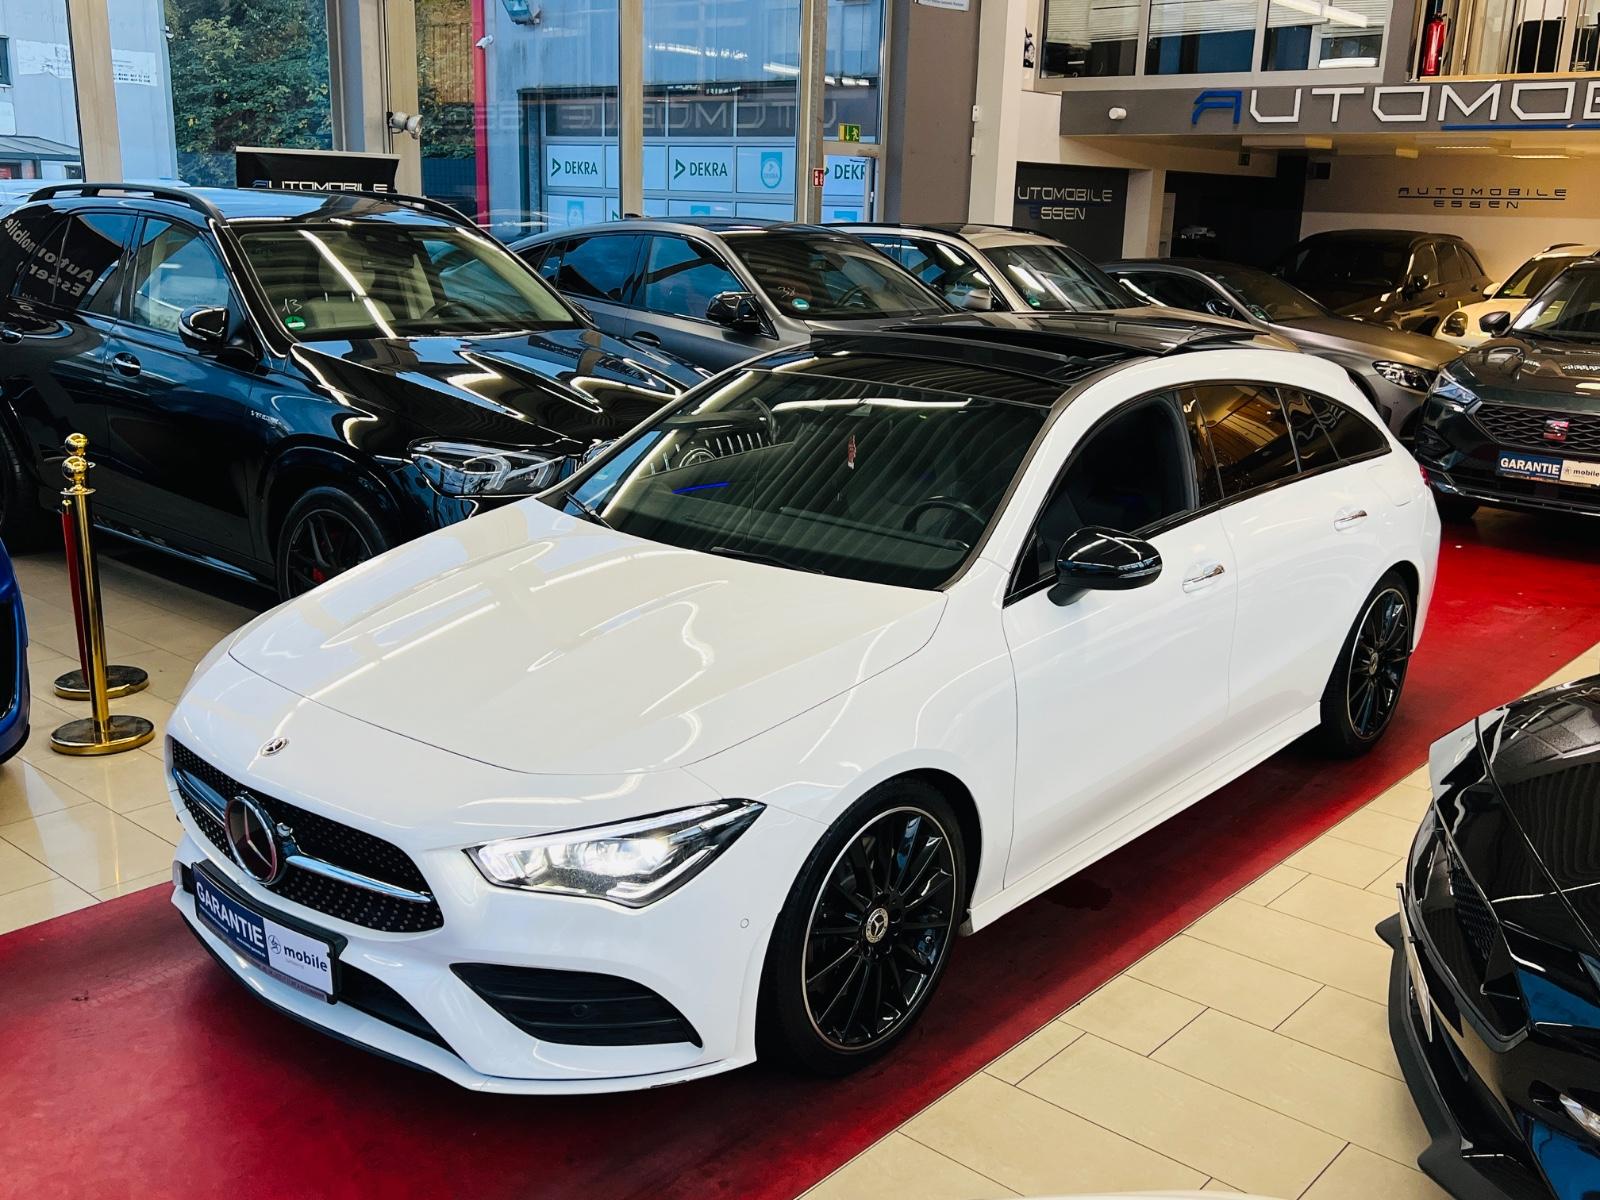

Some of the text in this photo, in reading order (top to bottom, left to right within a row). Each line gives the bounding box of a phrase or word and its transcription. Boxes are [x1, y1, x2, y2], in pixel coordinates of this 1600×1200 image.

[1191, 81, 1600, 125] AUTOMO
[565, 160, 598, 175] DEKRA
[689, 161, 728, 177] DEKRA
[1398, 187, 1567, 197] AUTOMOBILE
[1433, 200, 1519, 209] ESSEN
[1500, 457, 1561, 475] GARANTIE
[1573, 469, 1600, 477] mobile
[196, 881, 265, 949] GARANTIE
[283, 944, 328, 972] mobile
